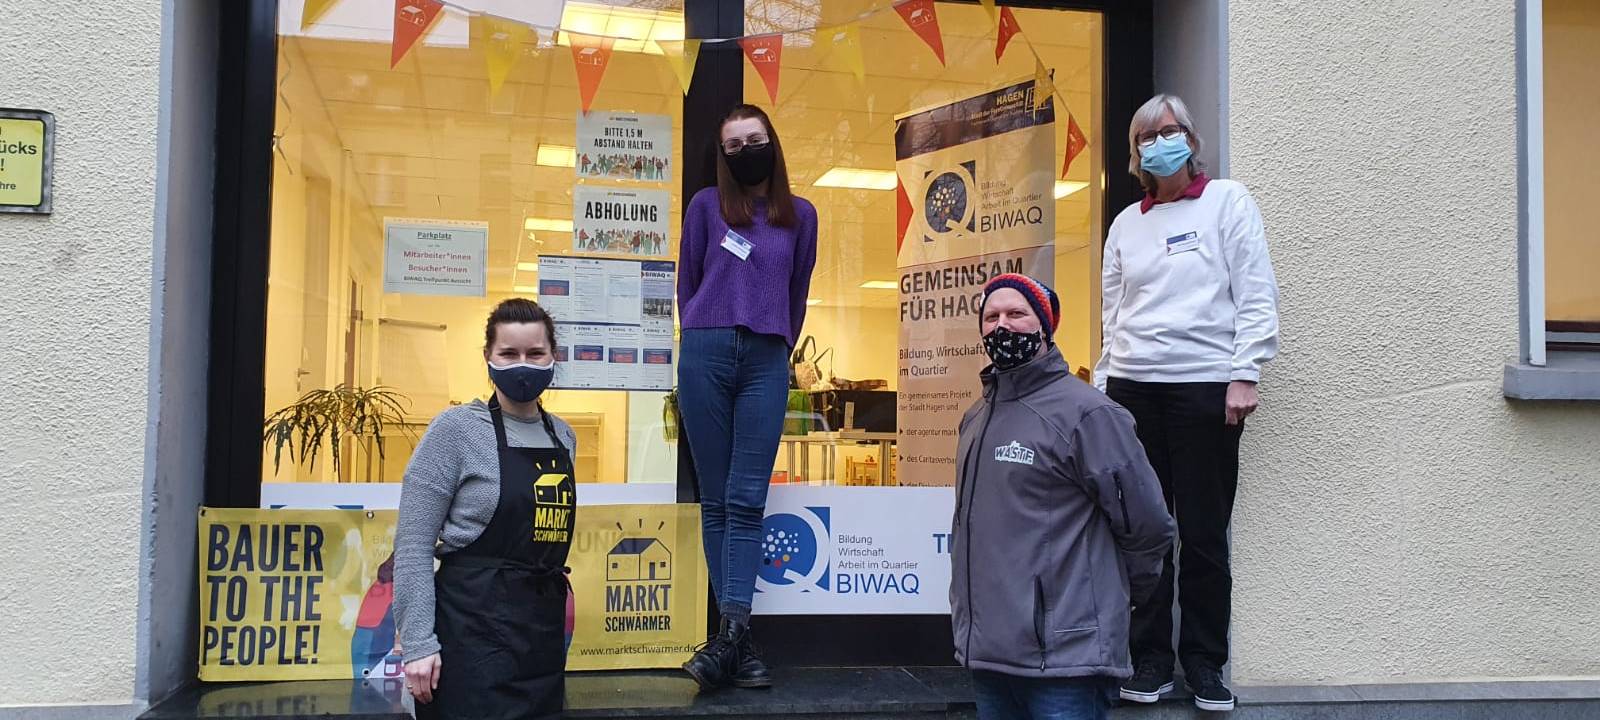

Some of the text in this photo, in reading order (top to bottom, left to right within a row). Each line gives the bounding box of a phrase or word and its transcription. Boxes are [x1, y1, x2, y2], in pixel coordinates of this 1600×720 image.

[996, 90, 1024, 106] HAGEN
[605, 127, 623, 137] BITTE
[626, 128, 635, 138] 1,5
[594, 138, 653, 150] ABSTAND HALTEN
[585, 201, 657, 222] ABHOLUNG
[981, 206, 1043, 233] BIWAQ
[417, 232, 452, 240] Parkplatz
[900, 257, 1023, 295] GEMEINSAM
[900, 293, 981, 322] FÜR HAG
[900, 365, 948, 376] im Quartier
[908, 391, 949, 401] gemeinsames
[950, 390, 972, 399] Projekt
[909, 403, 925, 411] Stadt
[927, 403, 945, 412] Hagen
[947, 403, 959, 411] und
[917, 429, 940, 437] agentur
[907, 455, 918, 463] des
[534, 508, 571, 529] MARKT
[207, 524, 324, 572] BAUER
[838, 535, 873, 546] Bildung
[838, 547, 884, 557] Wirtschaft
[838, 560, 918, 570] Arbeit im Quartier
[837, 573, 919, 594] BIWAQ
[206, 576, 324, 622] TO THE
[606, 585, 672, 612] MARKT
[605, 613, 671, 632] SCHWÄRMER
[202, 625, 320, 665] PEOPLE!
